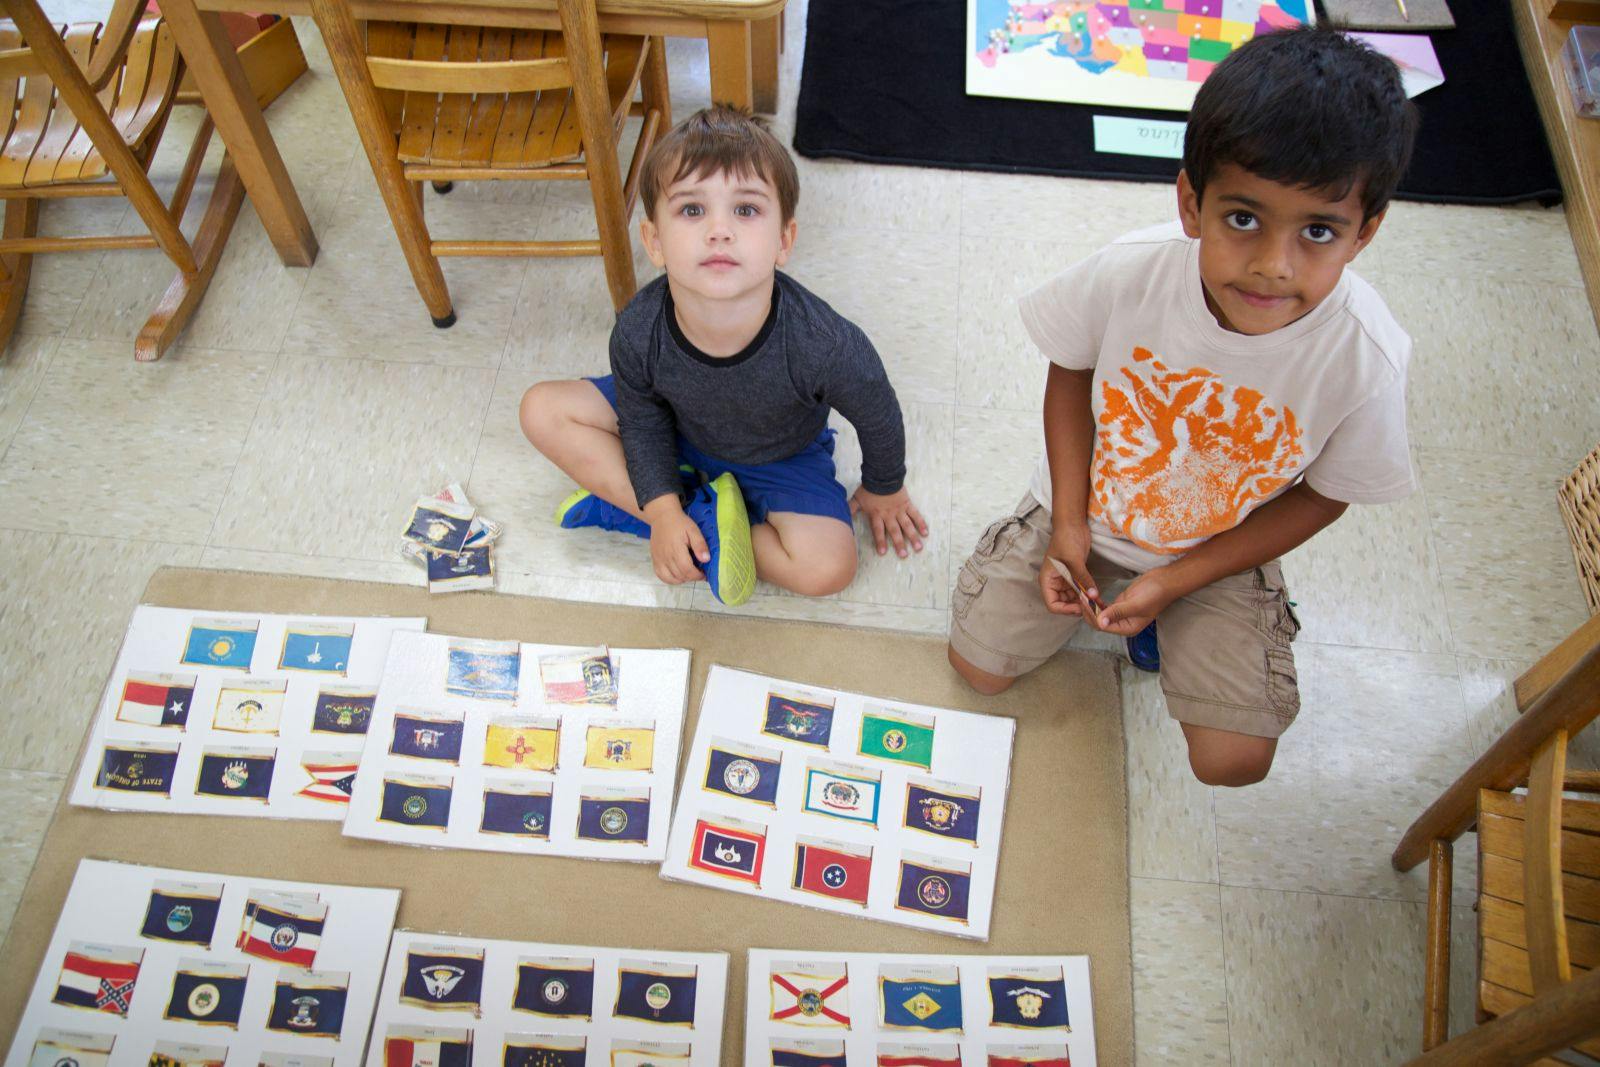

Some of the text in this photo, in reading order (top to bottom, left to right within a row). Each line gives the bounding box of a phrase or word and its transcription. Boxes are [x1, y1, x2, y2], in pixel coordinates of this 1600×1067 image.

[1136, 126, 1186, 149] lina
[105, 772, 164, 787] STATE OF OREGON
